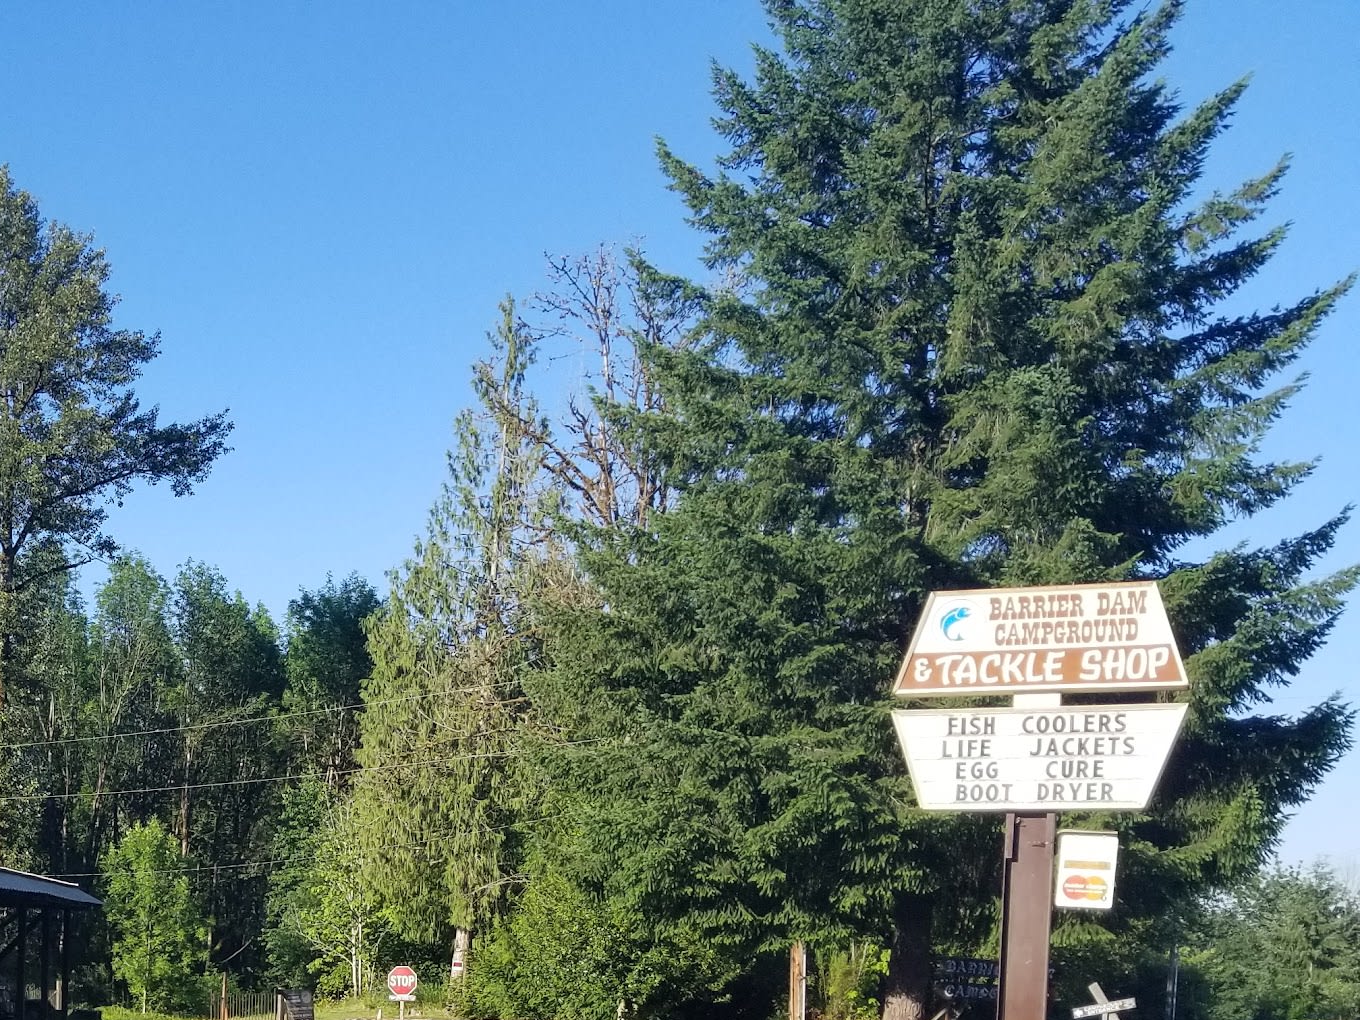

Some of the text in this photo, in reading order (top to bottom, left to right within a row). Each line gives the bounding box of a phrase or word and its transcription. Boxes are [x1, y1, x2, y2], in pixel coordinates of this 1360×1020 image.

[989, 590, 1147, 621] BARRIER DAM
[994, 617, 1139, 647] CAMPGROUND
[914, 647, 1169, 685] & TACKLE SHOP
[947, 713, 1127, 736] FISH COOLERS
[942, 737, 1135, 759] LIFE JACKETS
[955, 760, 1104, 780] EGG CURE
[955, 782, 1114, 802] BOOT DRYER
[946, 959, 999, 977] BARRI
[390, 975, 415, 987] STOP
